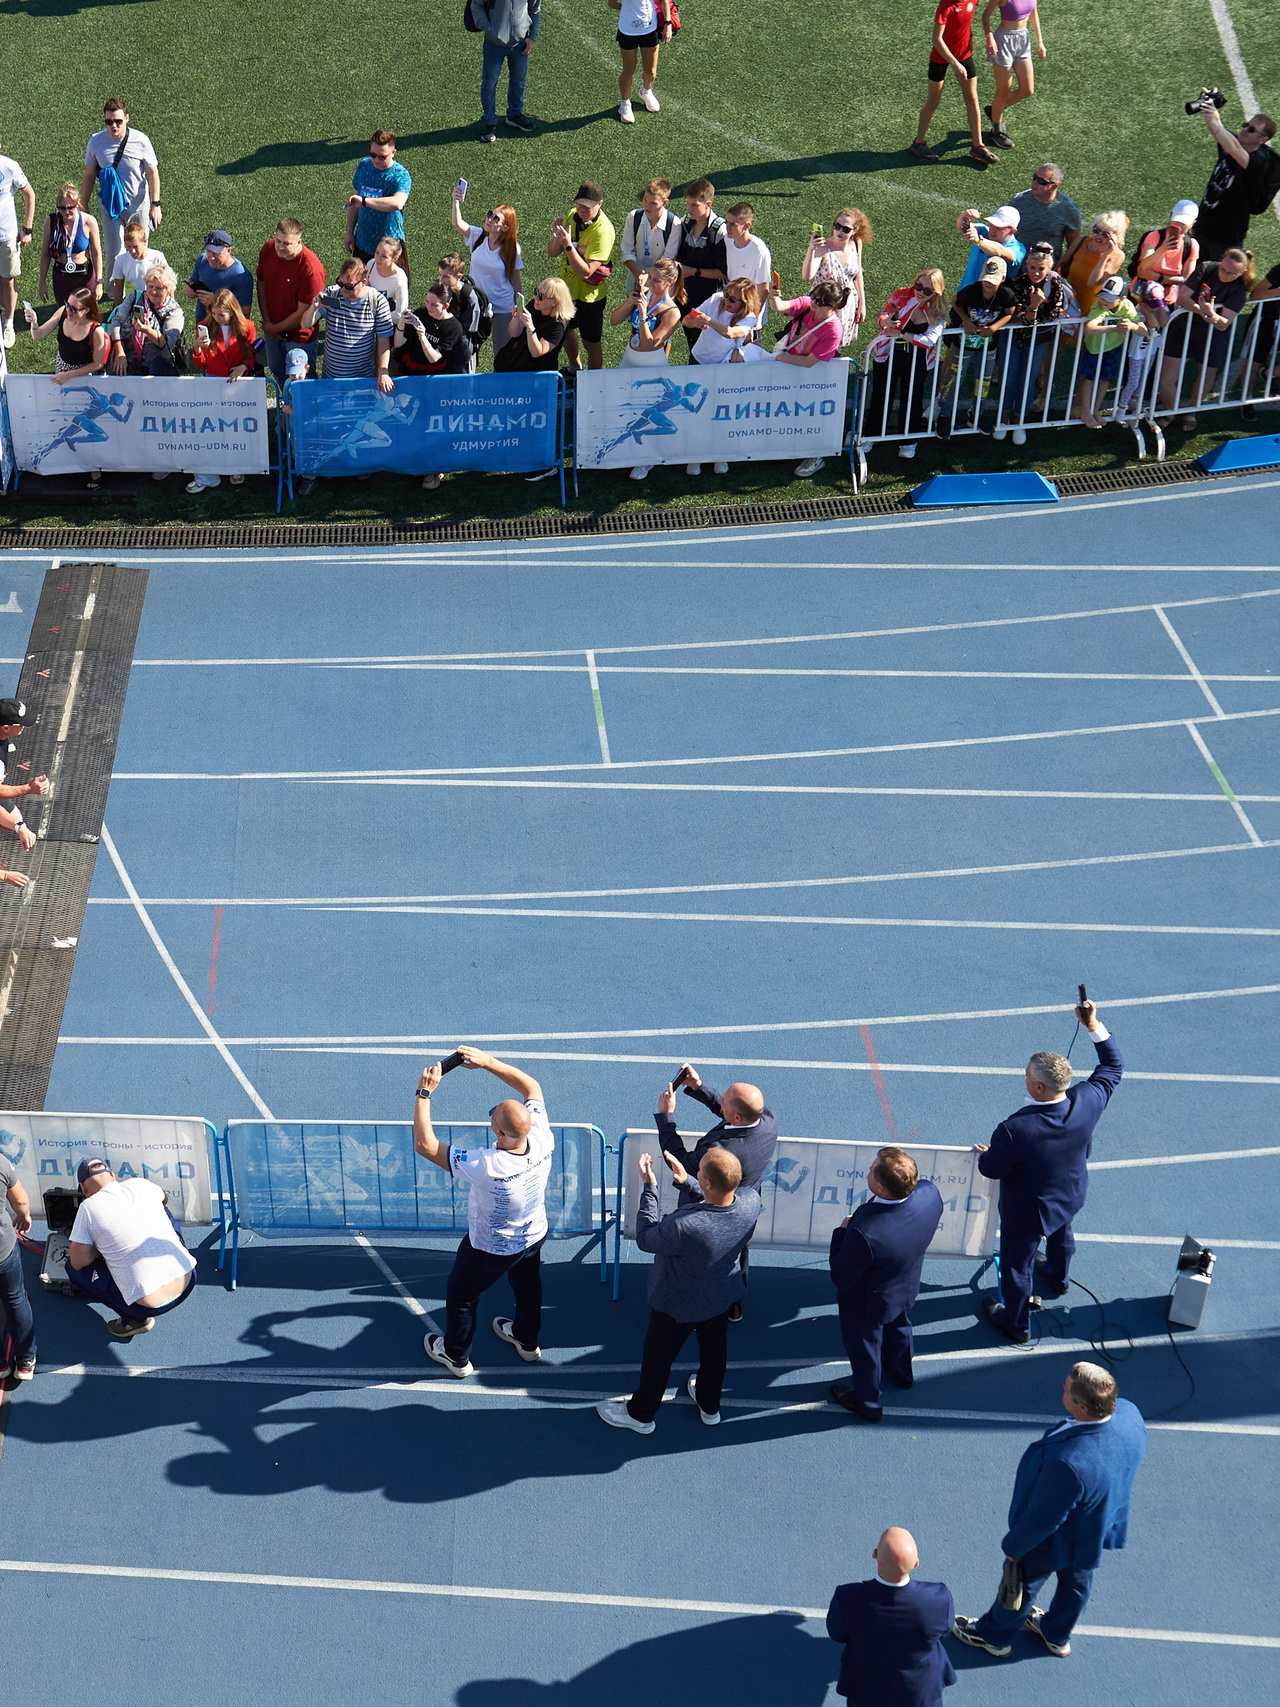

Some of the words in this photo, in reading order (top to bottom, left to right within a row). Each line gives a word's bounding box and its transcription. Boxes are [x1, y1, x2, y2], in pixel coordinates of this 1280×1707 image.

[717, 386, 755, 396] История
[758, 385, 791, 393] страны
[800, 382, 837, 391] история
[142, 399, 178, 408] История
[180, 400, 213, 408] страны
[221, 399, 257, 408] история
[440, 397, 531, 406] DYNAMO-UDM.RU
[711, 399, 836, 421] ДИНАМО
[140, 416, 258, 434] ДИНАМО
[425, 411, 547, 433] ДИНАМО
[728, 427, 821, 439] DYNAMO-UDM.RU
[158, 443, 247, 452] DYNAMO-UDM.RU
[451, 438, 519, 452] УДМУРТИЯ
[38, 1138, 88, 1149] История
[91, 1139, 133, 1150] страны
[36, 1158, 196, 1180] ДИАМО
[836, 1169, 968, 1185] DYNDM.RU
